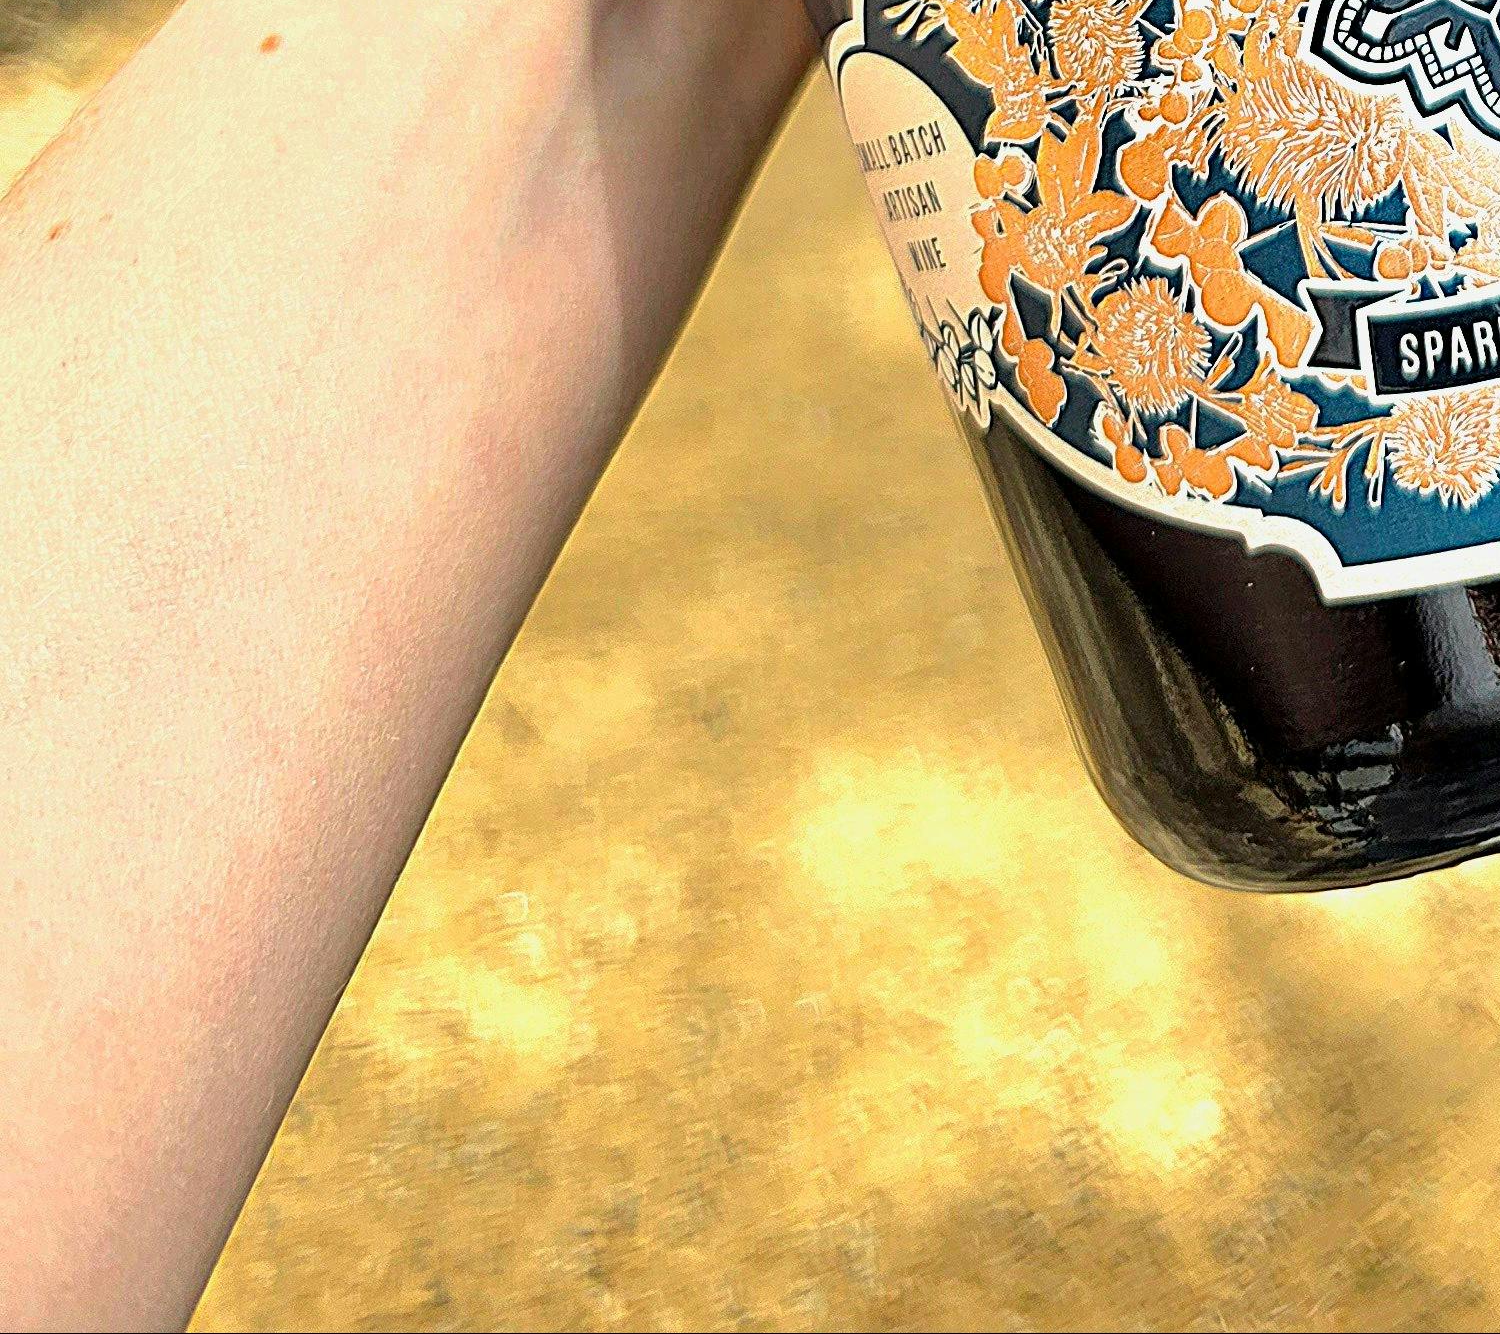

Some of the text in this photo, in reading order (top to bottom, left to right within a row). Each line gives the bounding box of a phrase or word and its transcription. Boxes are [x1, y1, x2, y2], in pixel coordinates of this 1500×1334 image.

[888, 120, 947, 165] BATCH
[883, 180, 942, 222] ARTISAN
[907, 236, 947, 272] WINE
